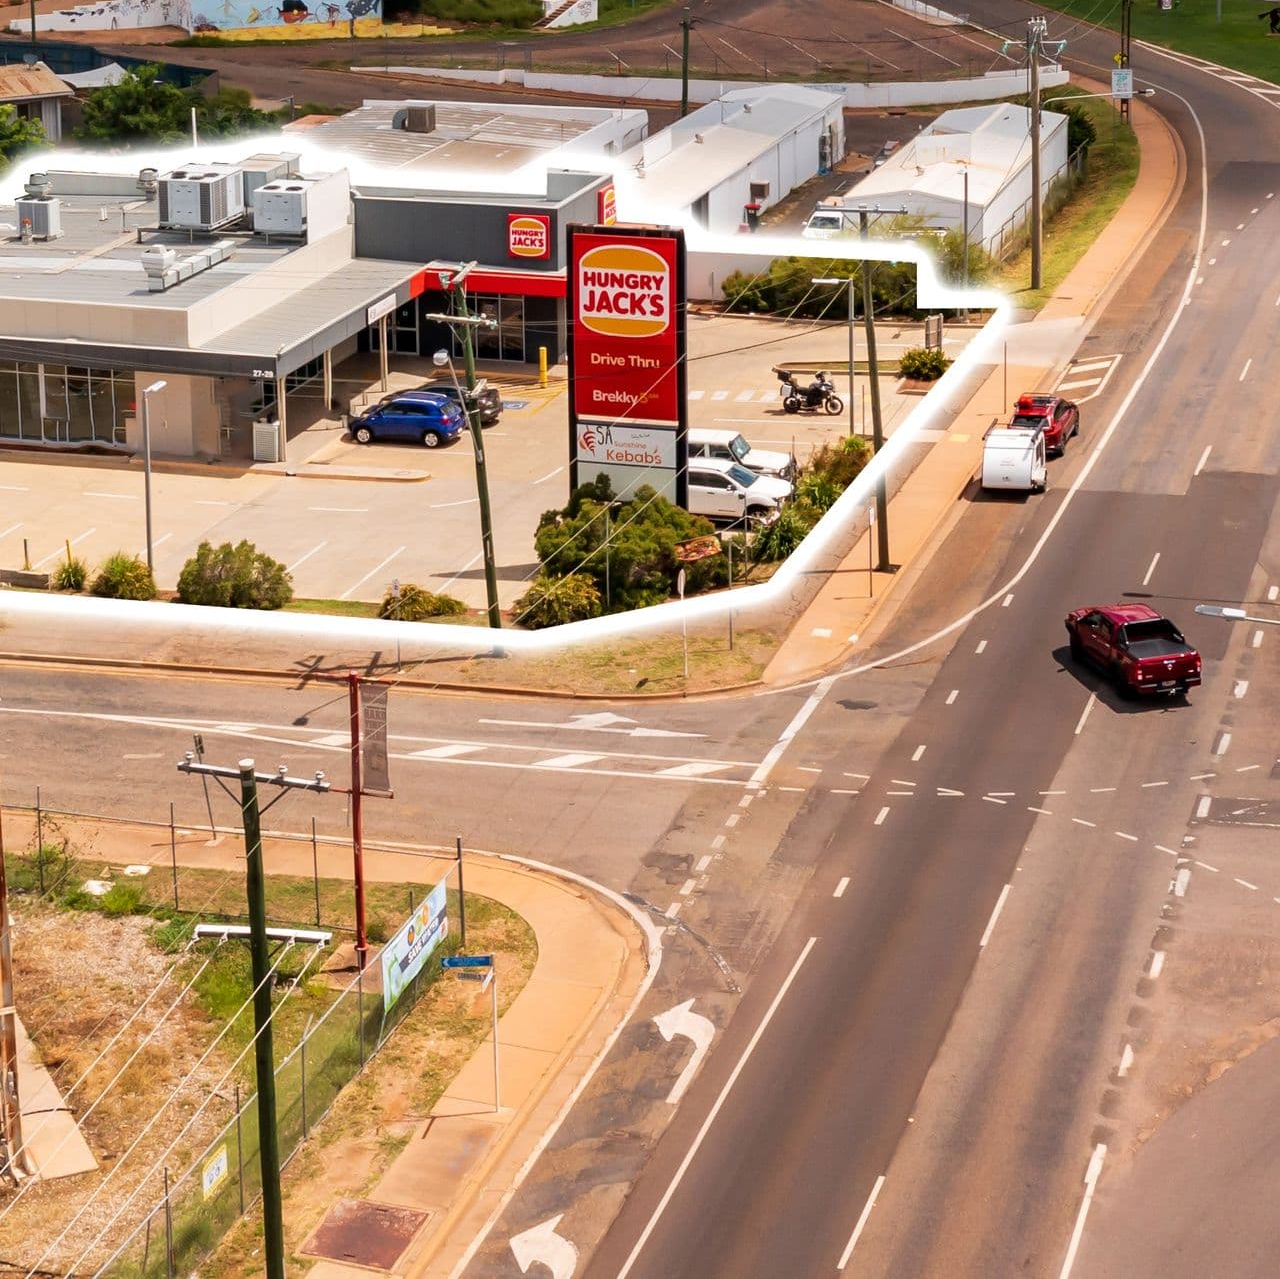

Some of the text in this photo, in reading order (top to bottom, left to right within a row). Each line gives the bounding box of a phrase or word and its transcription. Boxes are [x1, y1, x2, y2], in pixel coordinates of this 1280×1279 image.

[512, 229, 544, 237] HUNGRY
[511, 237, 544, 247] JACK'S
[583, 270, 665, 291] HUNGRY
[583, 290, 665, 317] JACK'S
[590, 352, 660, 369] Drive Thru
[592, 388, 639, 406] Brekky
